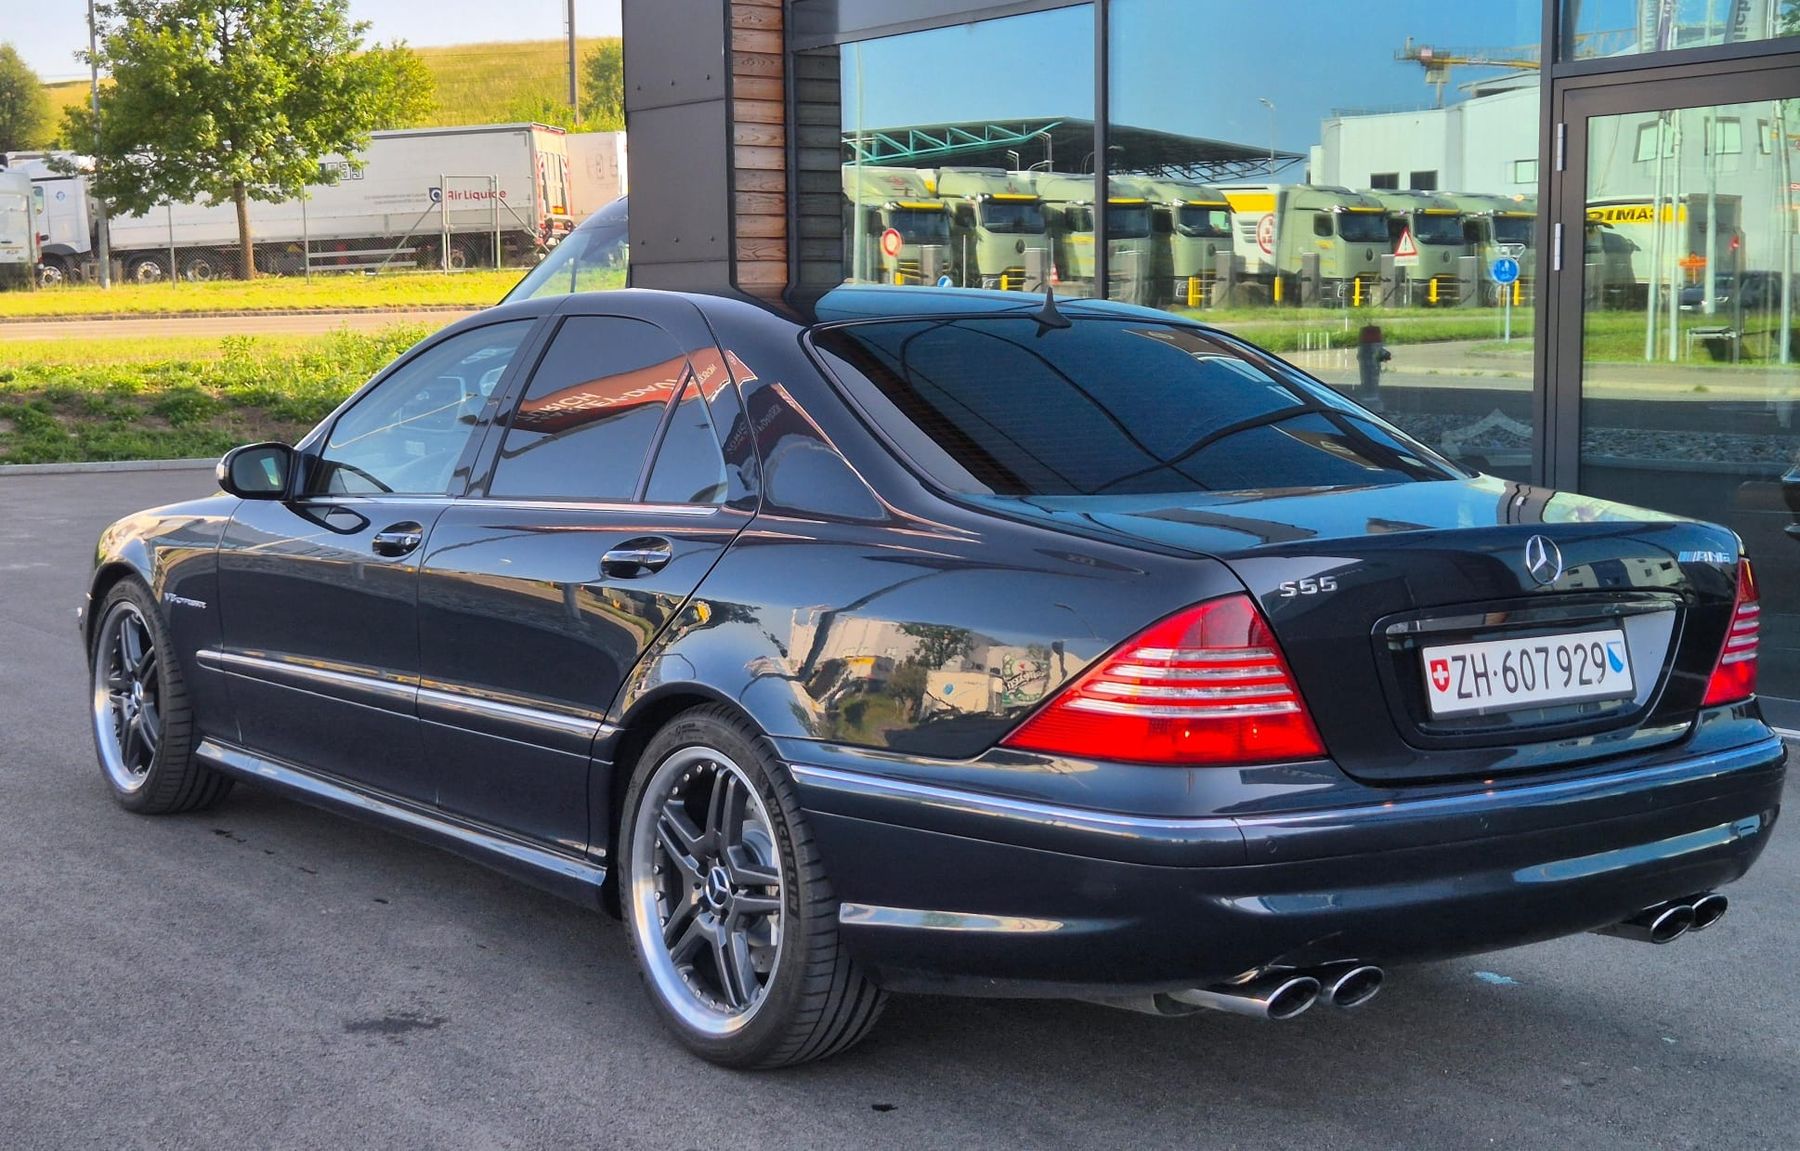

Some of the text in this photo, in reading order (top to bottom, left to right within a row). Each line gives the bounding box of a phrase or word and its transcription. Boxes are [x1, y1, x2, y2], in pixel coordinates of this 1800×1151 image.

[447, 190, 462, 201] Air
[1280, 576, 1338, 597] S55
[767, 797, 799, 917] MICHELIN
